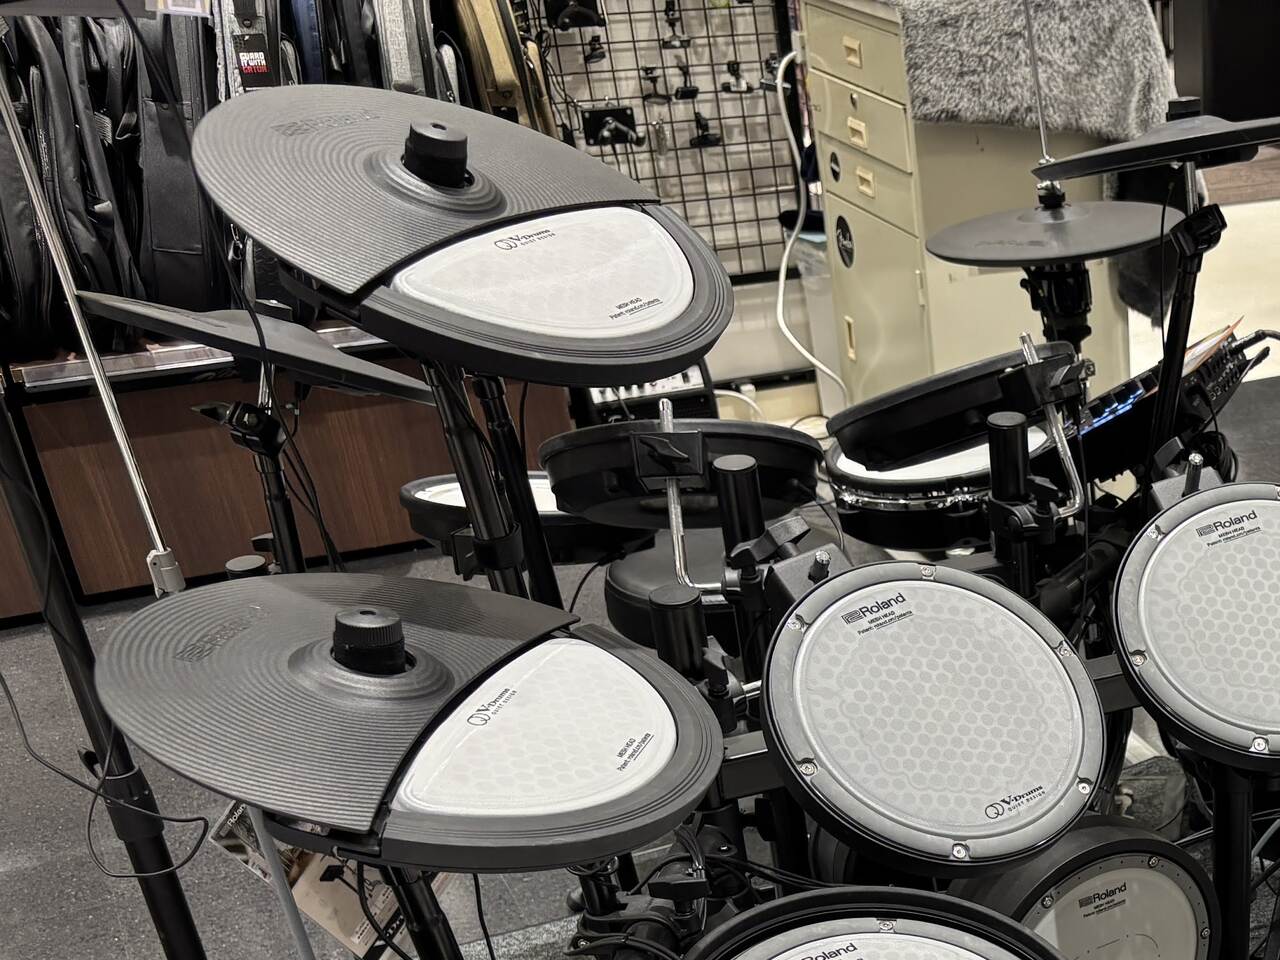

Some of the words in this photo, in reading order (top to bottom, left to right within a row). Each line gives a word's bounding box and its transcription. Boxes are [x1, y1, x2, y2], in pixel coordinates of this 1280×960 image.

[239, 51, 265, 61] GUARD
[241, 60, 249, 68] IT
[249, 58, 267, 67] WITH
[509, 229, 550, 243] V-Drums
[1213, 510, 1258, 531] Roland
[1218, 530, 1232, 538] MESH
[1232, 526, 1245, 534] HEAD
[859, 592, 907, 617] Roland
[868, 615, 882, 624] MESH
[882, 610, 896, 619] HEAD
[476, 687, 510, 713] V-Drums
[1000, 785, 1043, 806] V-Drums
[1008, 801, 1024, 812] QUIET
[227, 803, 247, 828] Rolan
[1092, 882, 1127, 903] Roland
